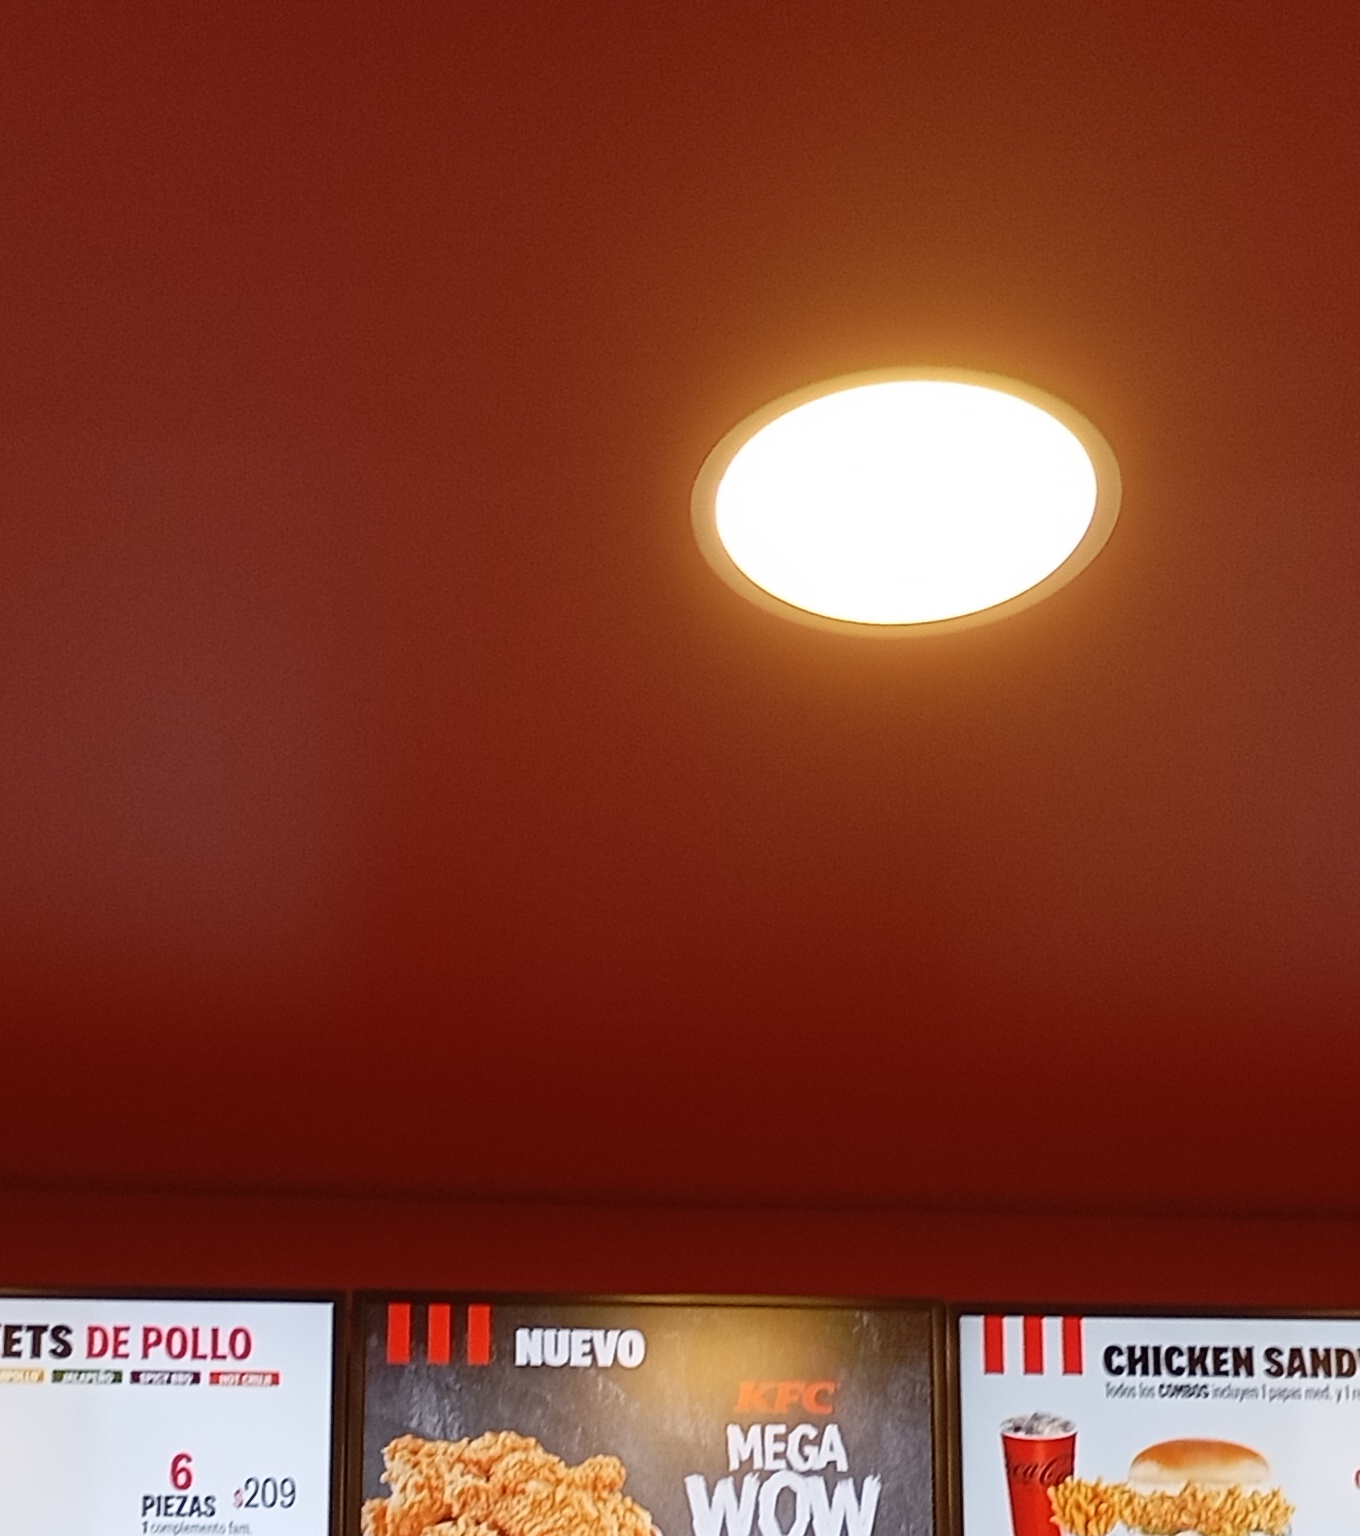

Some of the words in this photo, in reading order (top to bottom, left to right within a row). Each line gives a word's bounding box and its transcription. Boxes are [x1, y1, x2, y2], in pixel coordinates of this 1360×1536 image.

[86, 1327, 130, 1359] DE
[141, 1327, 252, 1360] POLLO
[515, 1329, 645, 1367] NUEVO
[1103, 1345, 1254, 1378] CHICKEN
[733, 1380, 838, 1414] KFC
[727, 1424, 848, 1472] MEGA
[170, 1453, 193, 1489] 6
[142, 1496, 216, 1517] PIEZAS
[234, 1478, 296, 1508] $209
